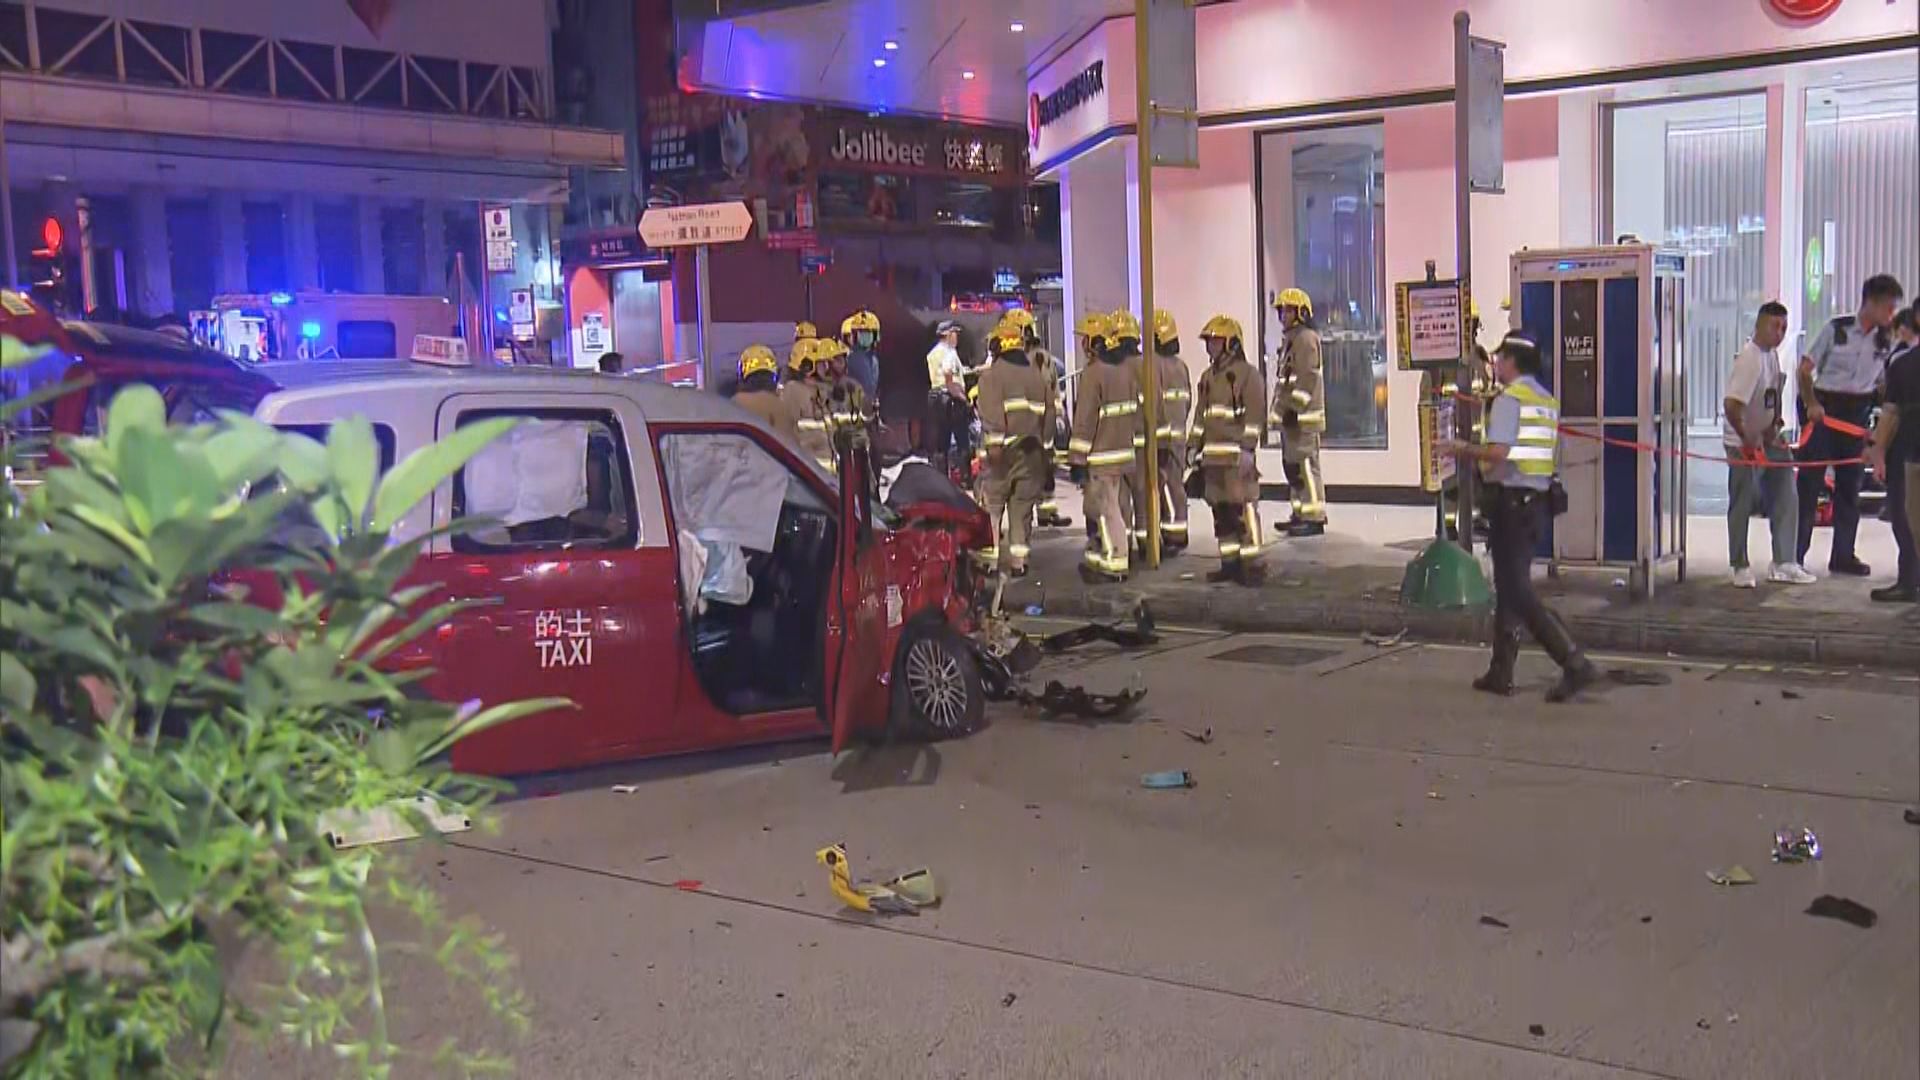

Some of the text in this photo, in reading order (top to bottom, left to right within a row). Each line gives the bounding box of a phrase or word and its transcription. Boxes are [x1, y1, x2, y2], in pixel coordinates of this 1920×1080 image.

[831, 127, 925, 166] Jollibee
[1564, 335, 1594, 349] Wi-Fi
[535, 609, 593, 638] 的士
[534, 637, 593, 668] TAXI
